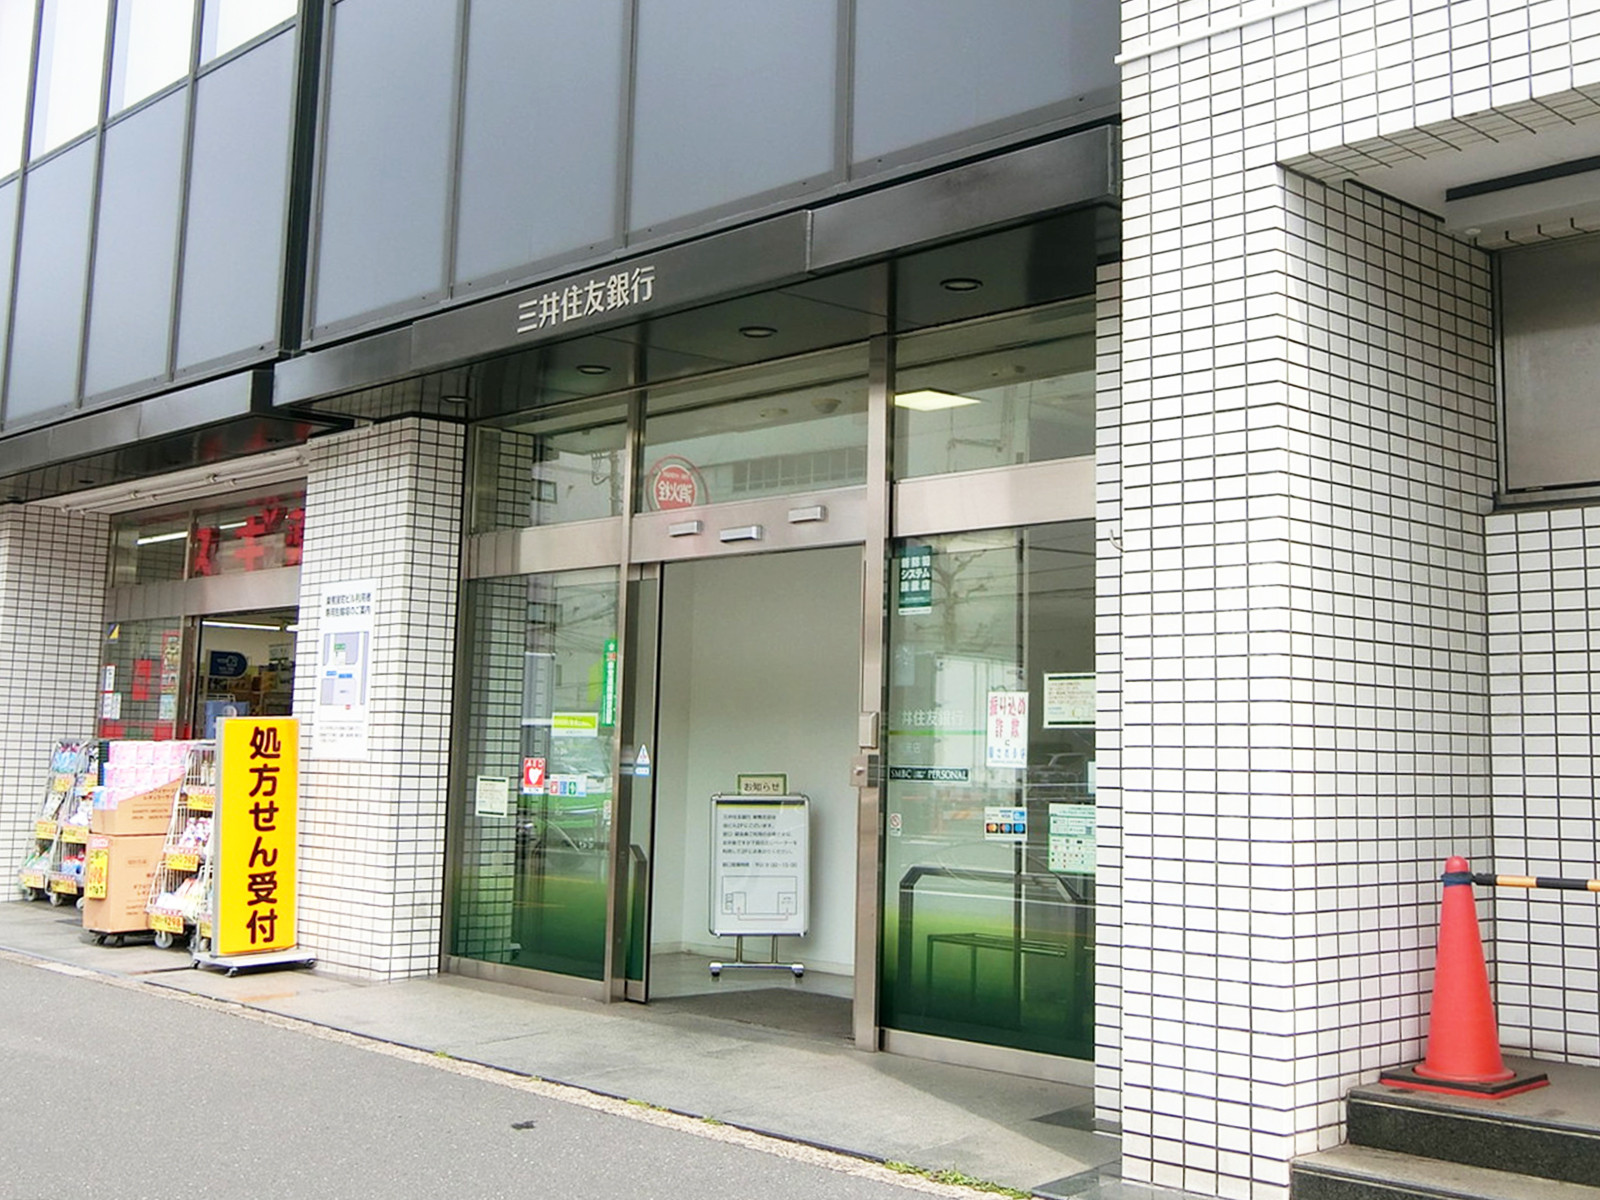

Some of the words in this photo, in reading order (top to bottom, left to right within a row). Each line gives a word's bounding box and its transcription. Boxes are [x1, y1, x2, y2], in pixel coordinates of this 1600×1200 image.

[517, 265, 656, 333] 三井住友銀行
[901, 567, 931, 580] システム
[900, 709, 964, 727] 井住友銀行
[525, 759, 545, 768] AED
[890, 769, 912, 779] SMBC
[927, 769, 968, 781] PERSONAL
[743, 782, 781, 792] お知らせ
[246, 726, 281, 944] 処方せん受付
